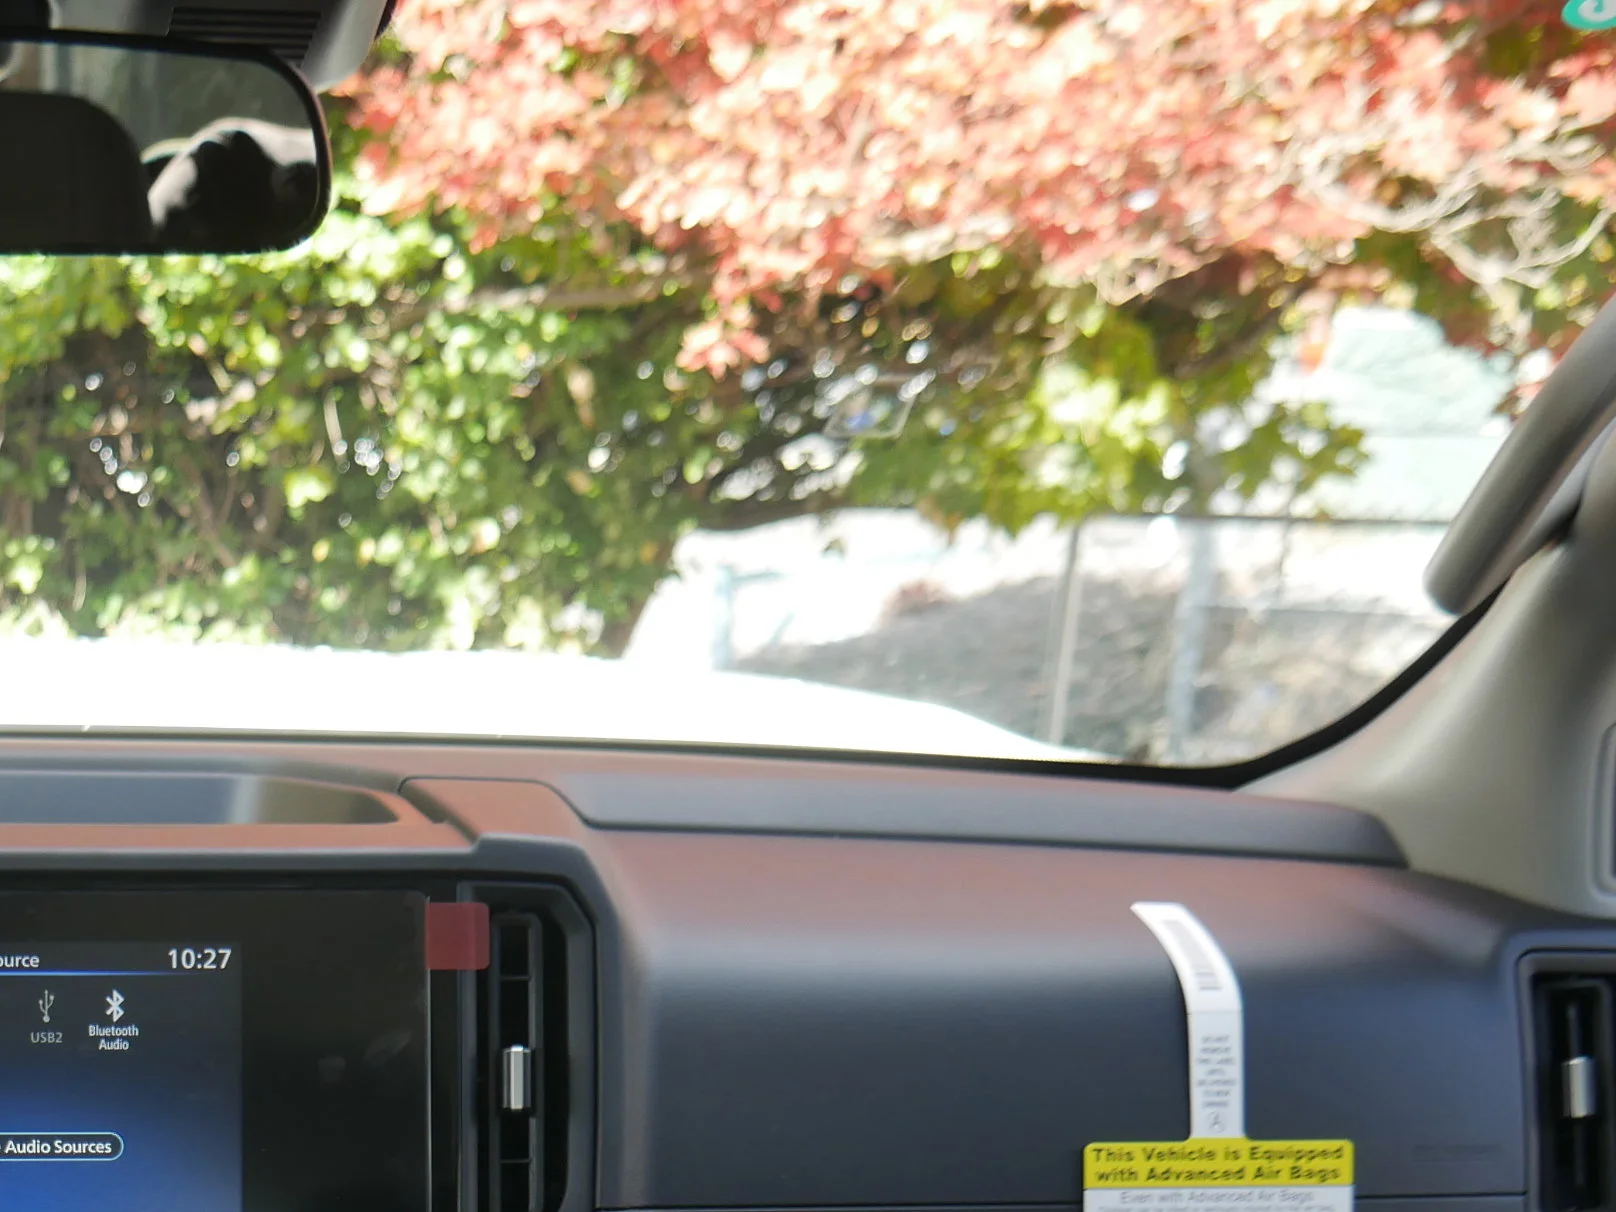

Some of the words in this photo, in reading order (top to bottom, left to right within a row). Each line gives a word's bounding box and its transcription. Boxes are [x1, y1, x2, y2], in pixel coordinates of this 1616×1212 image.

[168, 948, 232, 970] 10:27
[30, 1031, 63, 1044] USB2
[88, 1024, 139, 1038] Bluetooth
[98, 1037, 129, 1051] Audio
[5, 1139, 50, 1154] Audio
[54, 1140, 112, 1154] Sources
[1093, 1147, 1135, 1162] This
[1143, 1146, 1216, 1161] Vehicle
[1224, 1146, 1241, 1161] is
[1250, 1145, 1344, 1166] Equipped
[1096, 1167, 1139, 1182] with
[1145, 1165, 1246, 1182] Advanced
[1252, 1166, 1282, 1181] Air
[1290, 1165, 1340, 1183] Bags
[1187, 1190, 1253, 1203] Advanced
